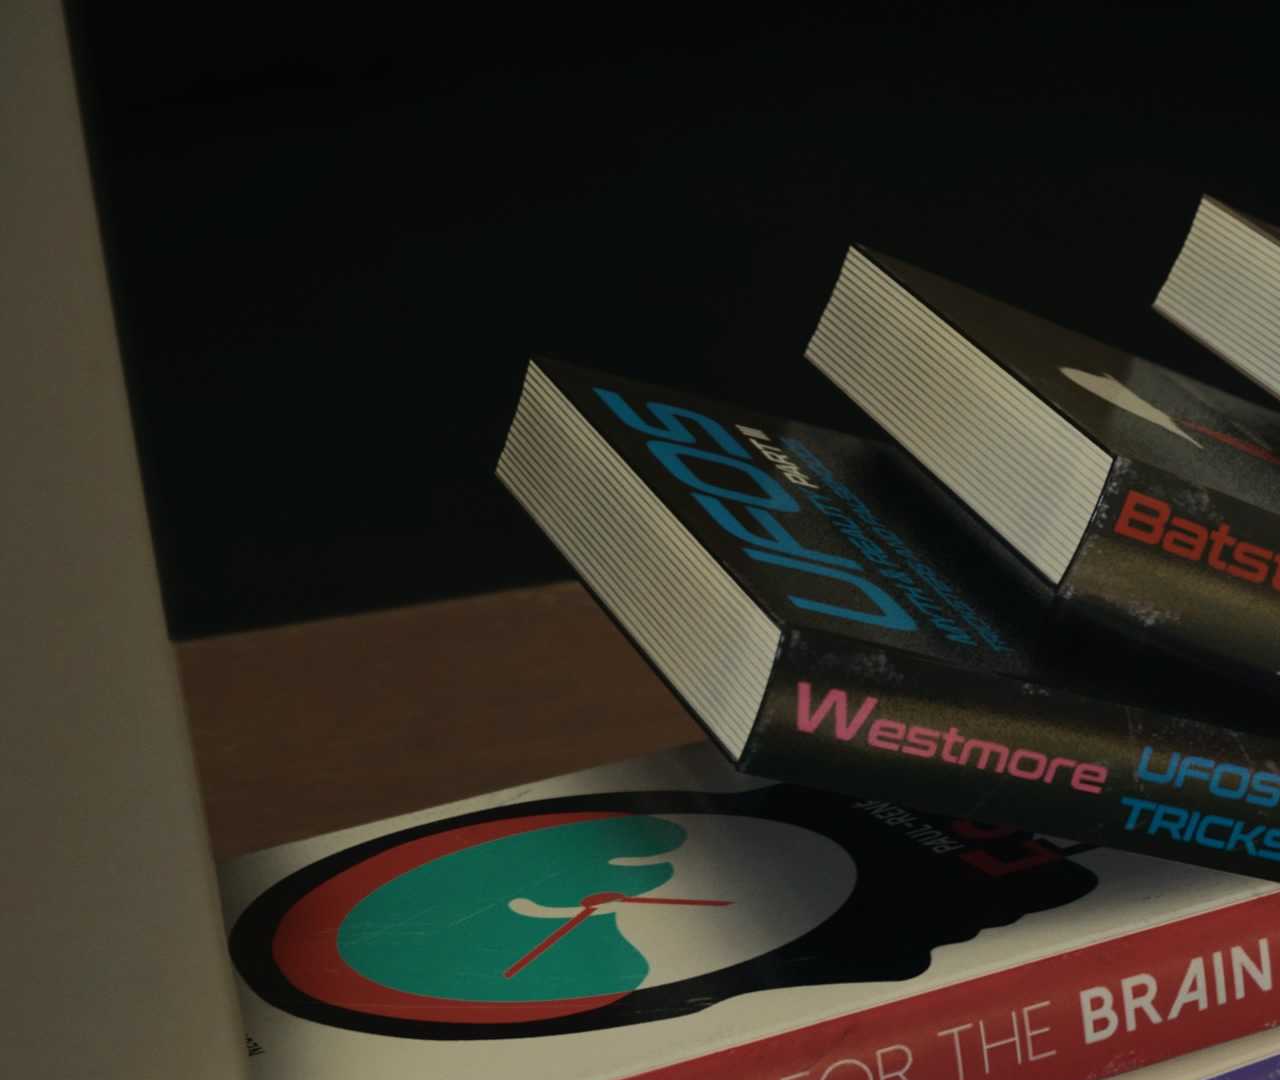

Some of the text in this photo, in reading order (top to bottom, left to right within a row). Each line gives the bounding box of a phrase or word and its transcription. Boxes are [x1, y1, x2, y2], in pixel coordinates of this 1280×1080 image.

[592, 386, 918, 632] UFOS
[795, 680, 1108, 796] Westmore
[1079, 937, 1274, 1046] BRAIN
